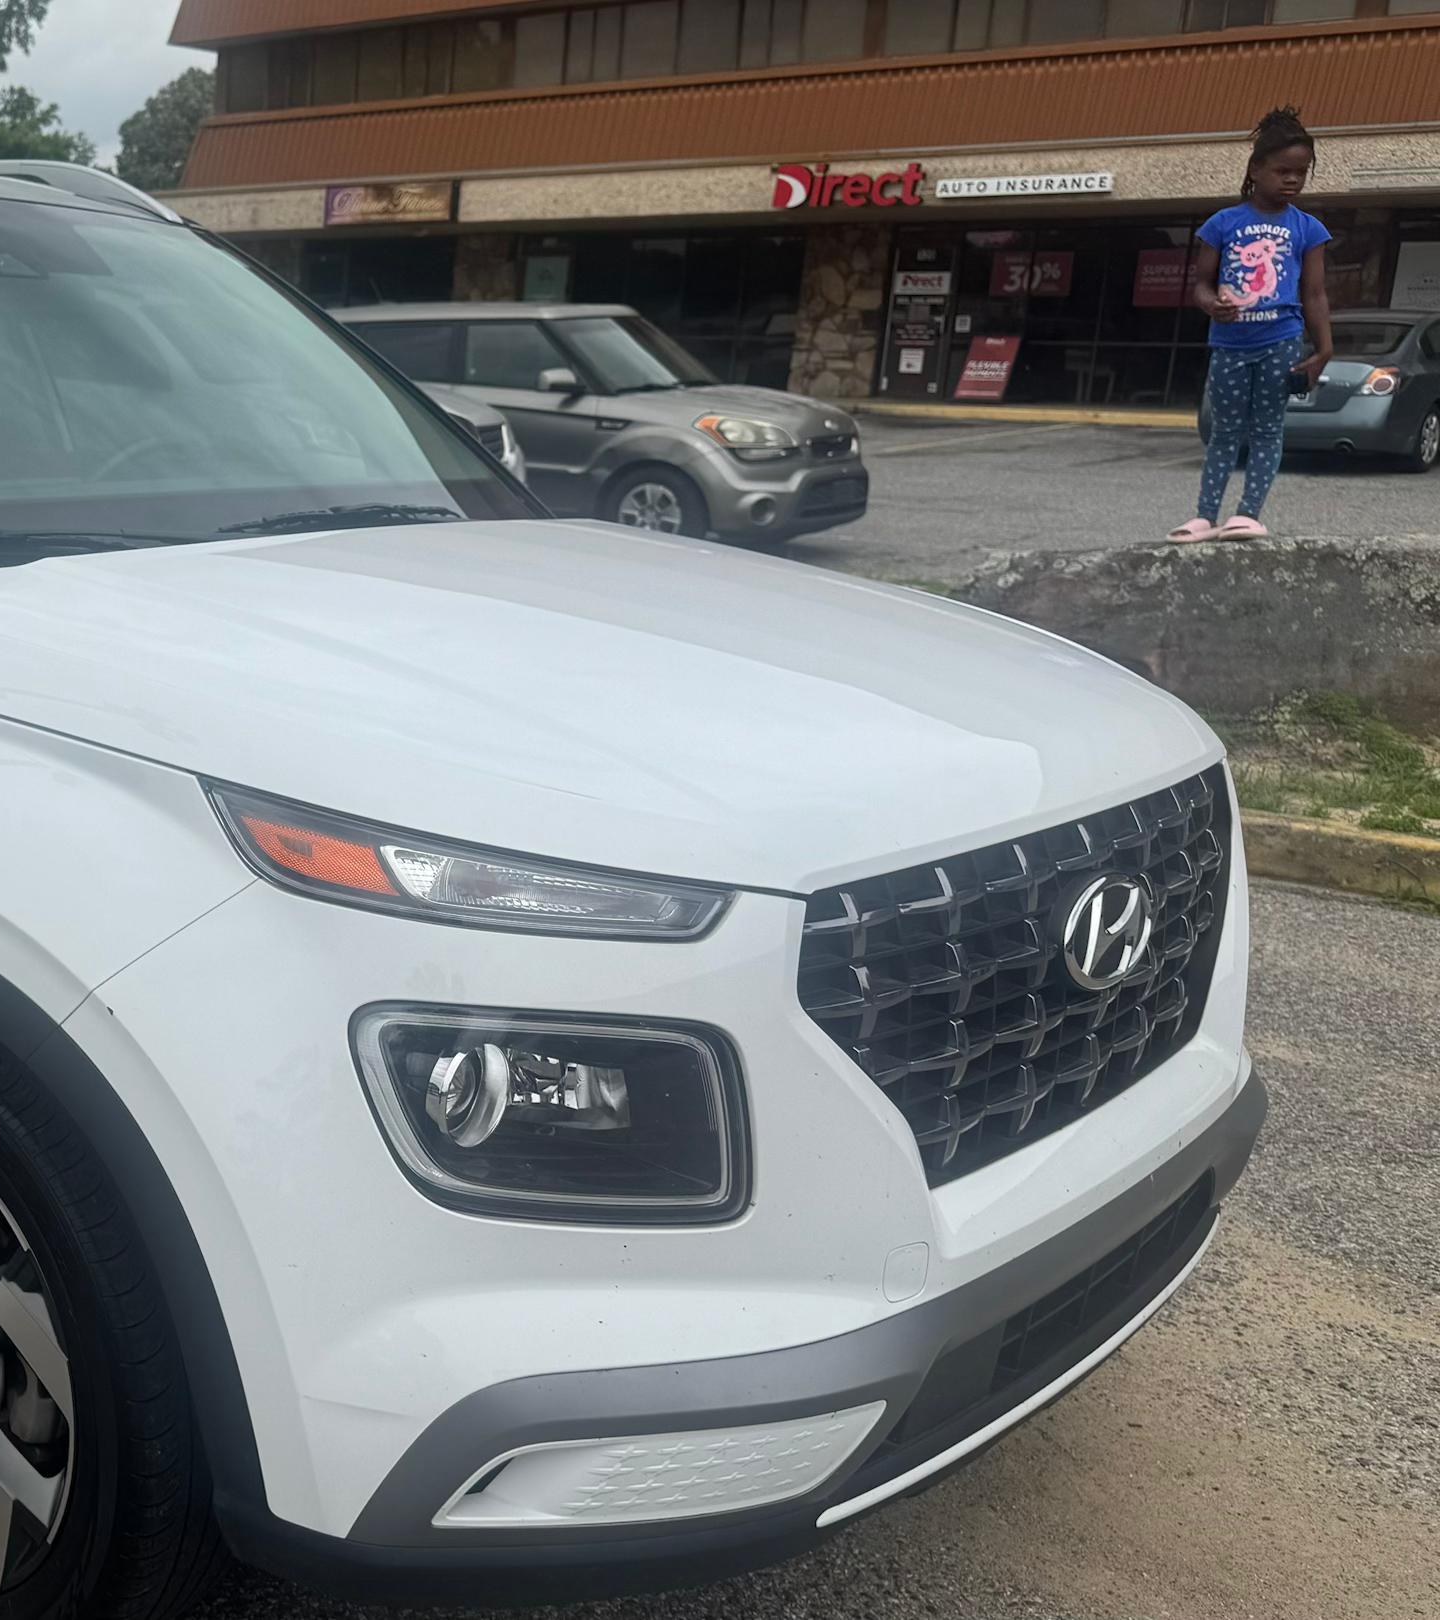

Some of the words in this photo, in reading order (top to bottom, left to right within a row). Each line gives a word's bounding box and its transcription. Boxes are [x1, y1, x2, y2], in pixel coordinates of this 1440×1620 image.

[771, 163, 924, 209] Direct
[938, 181, 988, 195] AUTO
[995, 175, 1110, 193] INSURANCE
[1236, 229, 1243, 238] I
[1235, 309, 1279, 322] STIONS
